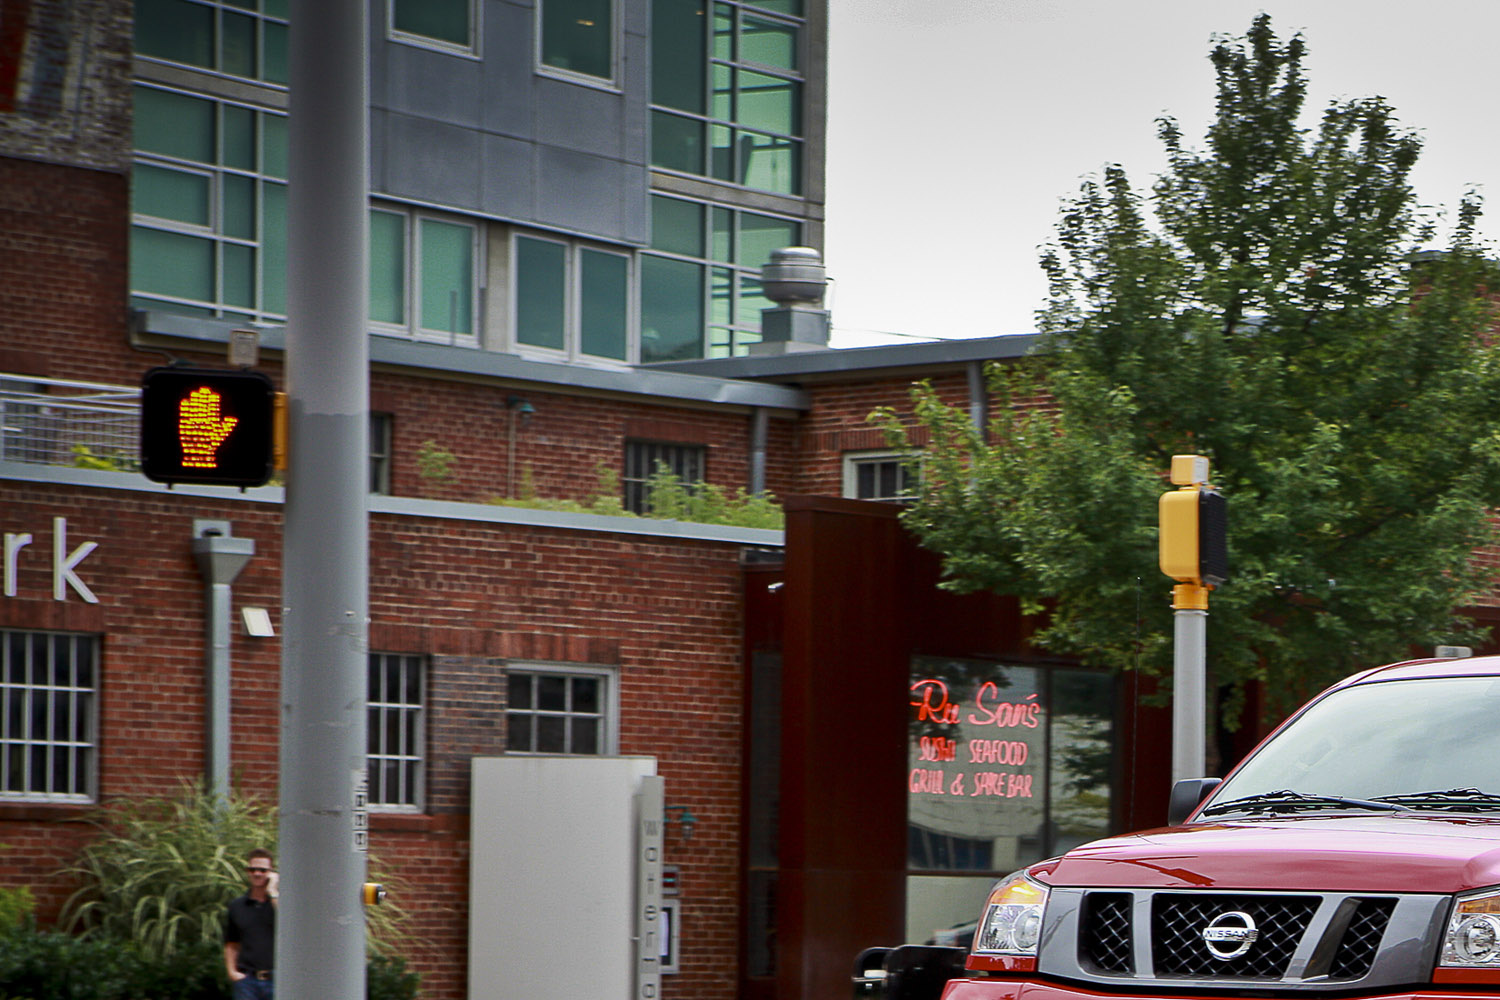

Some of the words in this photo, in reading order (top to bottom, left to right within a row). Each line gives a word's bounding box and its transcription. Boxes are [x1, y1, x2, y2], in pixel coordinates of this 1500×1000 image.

[910, 679, 961, 724] Ru
[969, 739, 1028, 766] SEAFOOD
[909, 768, 945, 794] GRILL
[950, 773, 965, 796] &
[970, 772, 1007, 797] SAKE
[1006, 774, 1033, 798] BAR
[1204, 930, 1249, 938] NISSAN
